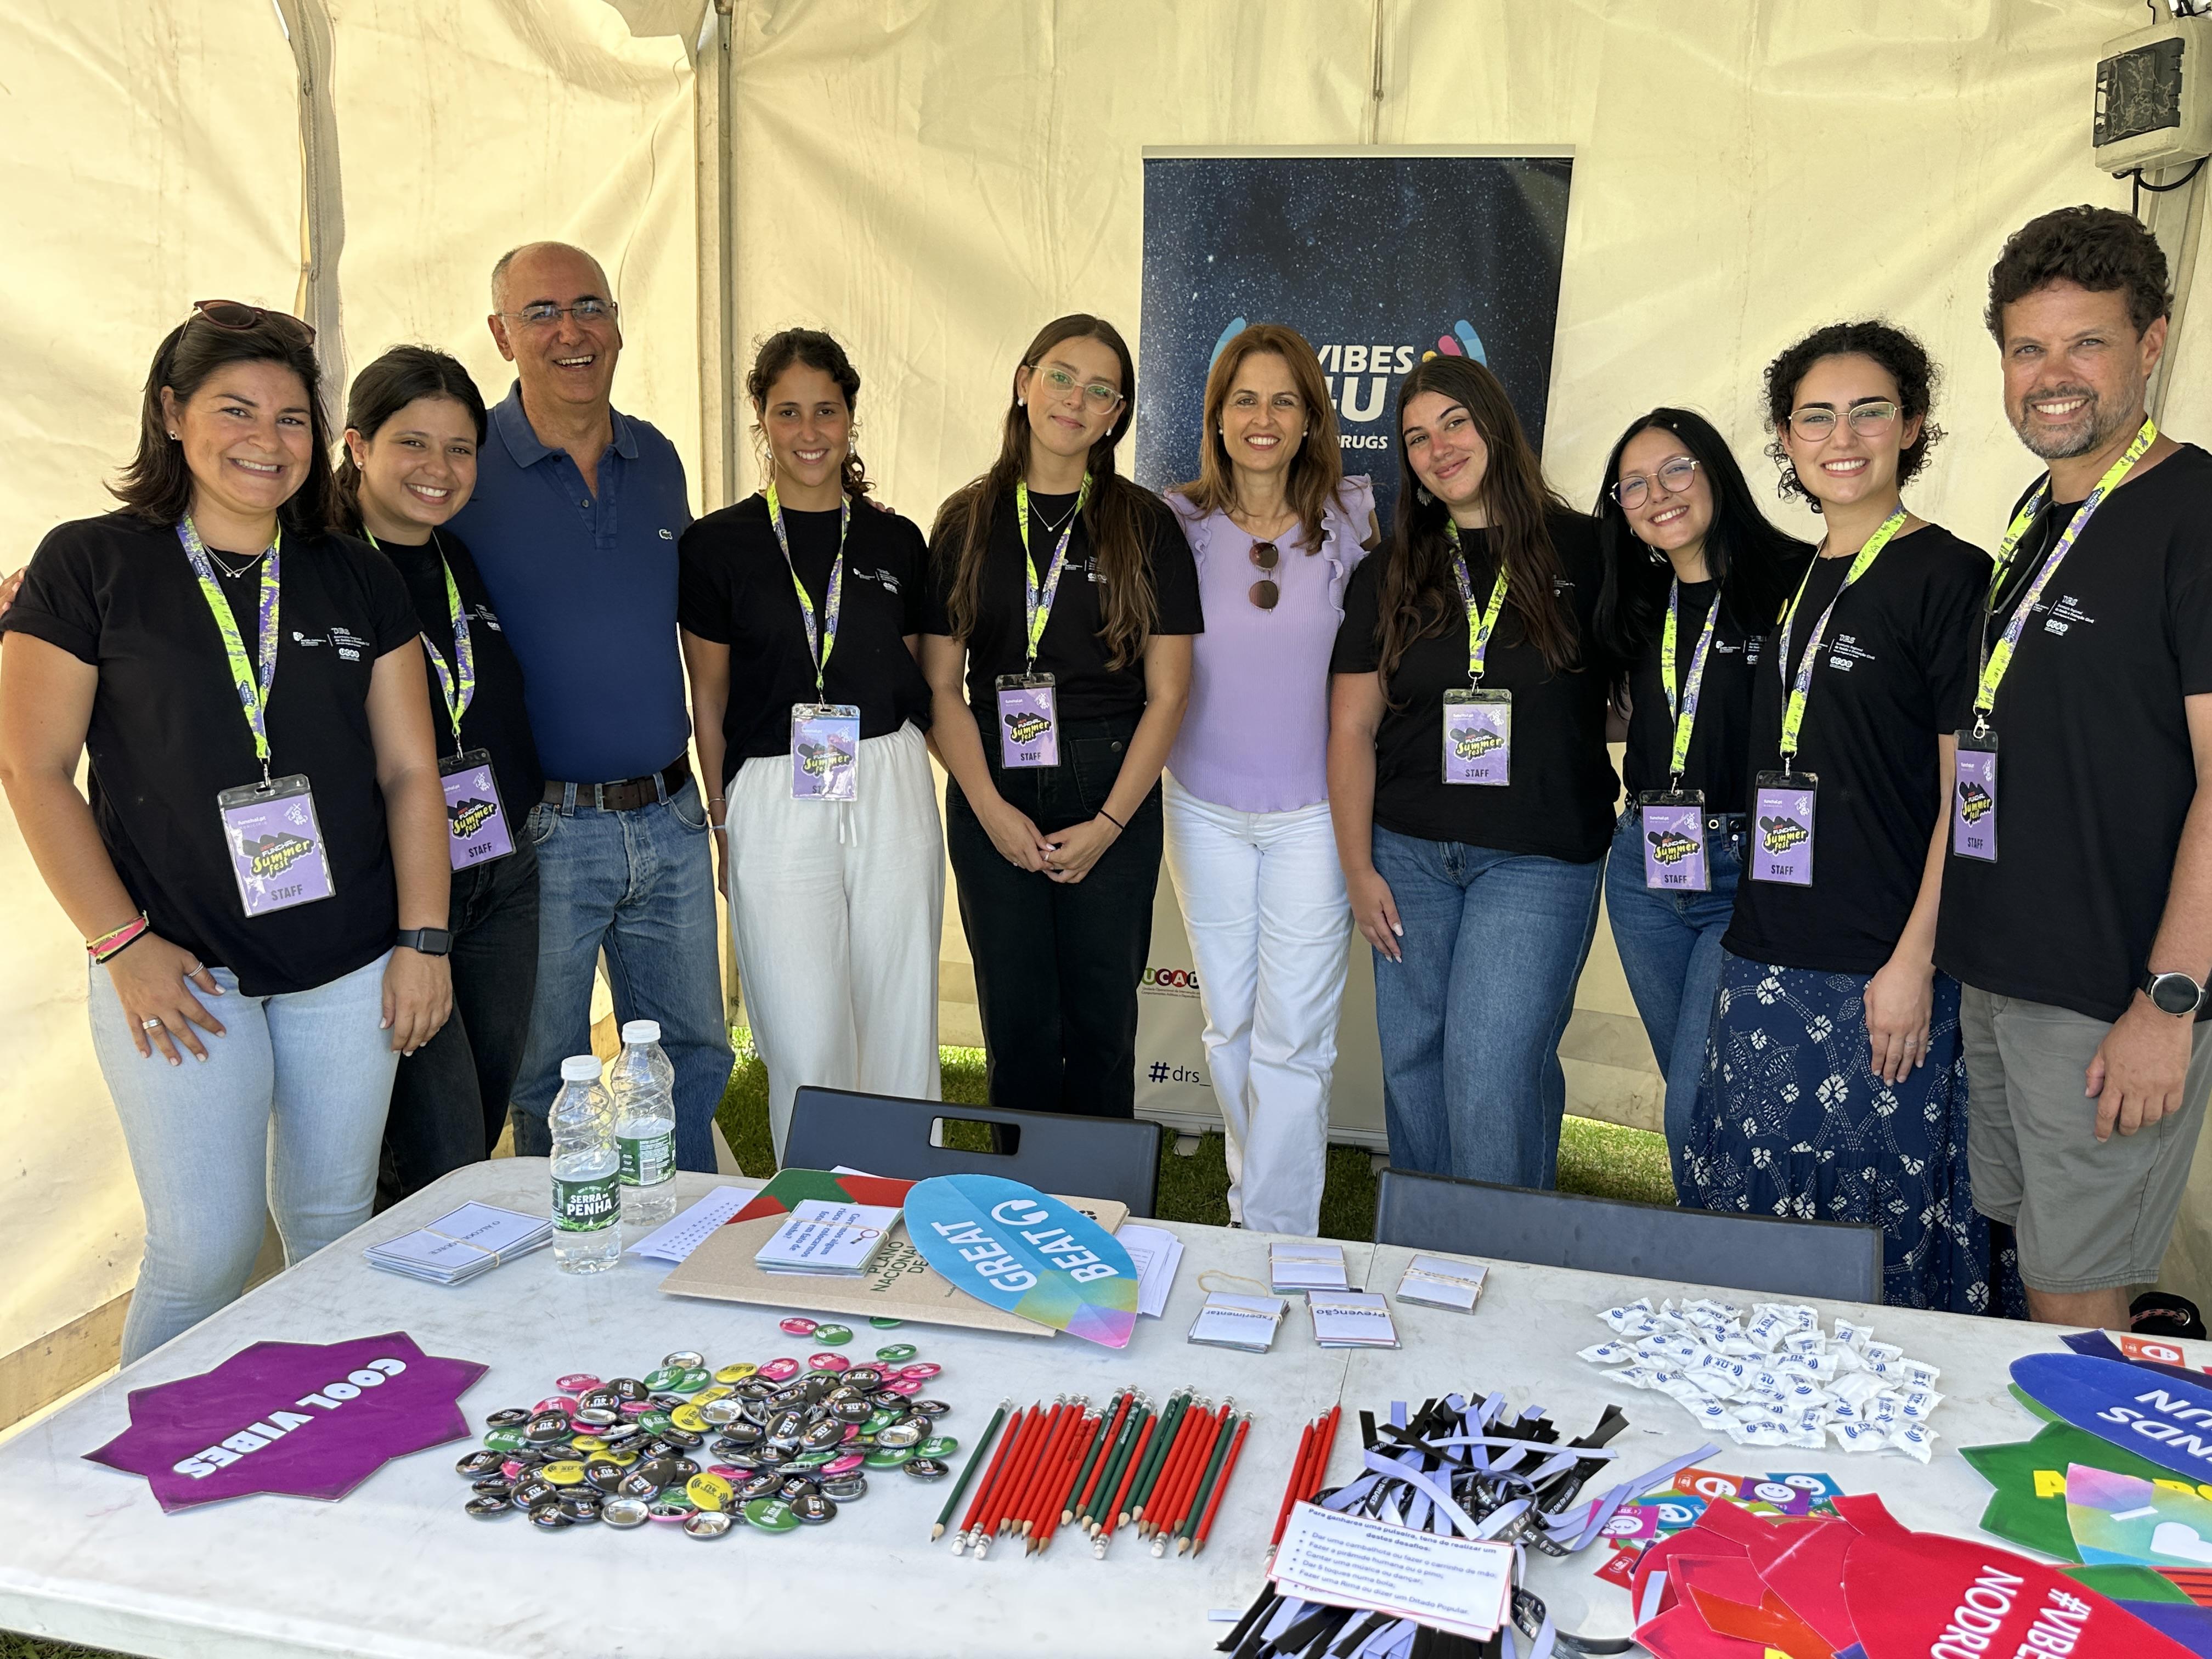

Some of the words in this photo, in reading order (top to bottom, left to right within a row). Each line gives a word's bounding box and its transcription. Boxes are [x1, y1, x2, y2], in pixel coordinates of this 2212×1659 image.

[1337, 435, 1388, 449] RUGS
[1012, 721, 1049, 738] Summer
[1021, 730, 1034, 742] fest
[1457, 738, 1502, 754] Summer
[1468, 747, 1483, 758] fest
[1020, 752, 1041, 761] STAFF
[1465, 769, 1489, 777] STAFF
[453, 804, 494, 834] Summer
[465, 820, 479, 835] fest
[1764, 830, 1807, 847] Summer
[1775, 840, 1789, 851] fest
[1967, 837, 1983, 849] STAFF
[252, 840, 311, 873] Summer
[469, 842, 492, 857] STAFF
[1655, 843, 1697, 858] Summer
[1666, 853, 1680, 863] fest
[269, 858, 289, 876] fest
[1771, 865, 1793, 875] STAFF
[1664, 874, 1687, 883] STAFF
[271, 884, 303, 901] STAFF
[1142, 968, 1199, 988] UCAD
[1148, 1061, 1211, 1087] #drs_
[567, 1198, 612, 1216] PENHA
[571, 1193, 602, 1204] SERRA
[814, 1211, 830, 1223] foto
[832, 1208, 847, 1221] risco
[796, 1233, 811, 1244] fato
[801, 1228, 830, 1257] colocarmos
[820, 1238, 838, 1255] algum
[428, 1241, 460, 1255] QUECE
[930, 1220, 1037, 1292] GREAT
[1020, 1228, 1119, 1283] BEAT
[868, 1241, 904, 1274] PLANO
[907, 1260, 929, 1273] DE
[1205, 1310, 1273, 1321] Experimentar
[1316, 1307, 1386, 1317] Prevenção
[295, 1358, 407, 1409] COOL
[2096, 1407, 2212, 1463] NDS
[173, 1410, 315, 1479] VIBES
[1370, 1483, 1384, 1505] DRUGS
[1308, 1508, 1325, 1517] Para
[1327, 1514, 1363, 1526] ganhares
[1383, 1527, 1418, 1540] pulseira,
[1420, 1536, 1437, 1544] tens
[1451, 1542, 1481, 1551] realizar
[1366, 1532, 1392, 1543] destes
[1394, 1539, 1431, 1552] desafios:
[1306, 1550, 1331, 1562] Cantar
[1309, 1542, 1329, 1551] Fazer
[1336, 1550, 1370, 1561] pirâmide
[1372, 1557, 1404, 1570] humana
[1424, 1570, 1443, 1579] pino;
[1346, 1542, 1391, 1556] cambalhota
[1404, 1554, 1422, 1564] fazer
[1431, 1562, 1464, 1572] carrinho
[1302, 1560, 1316, 1568] Dar
[1324, 1566, 1350, 1578] toques
[1352, 1573, 1375, 1583] numa
[1299, 1569, 1321, 1579] Fazer
[1322, 1577, 1339, 1585] uma
[1340, 1580, 1361, 1590] Rima
[1374, 1587, 1393, 1598] dizer
[1409, 1596, 1436, 1607] Ditado
[1437, 1603, 1470, 1615] Popular.
[2013, 1588, 2091, 1659] #VIBE
